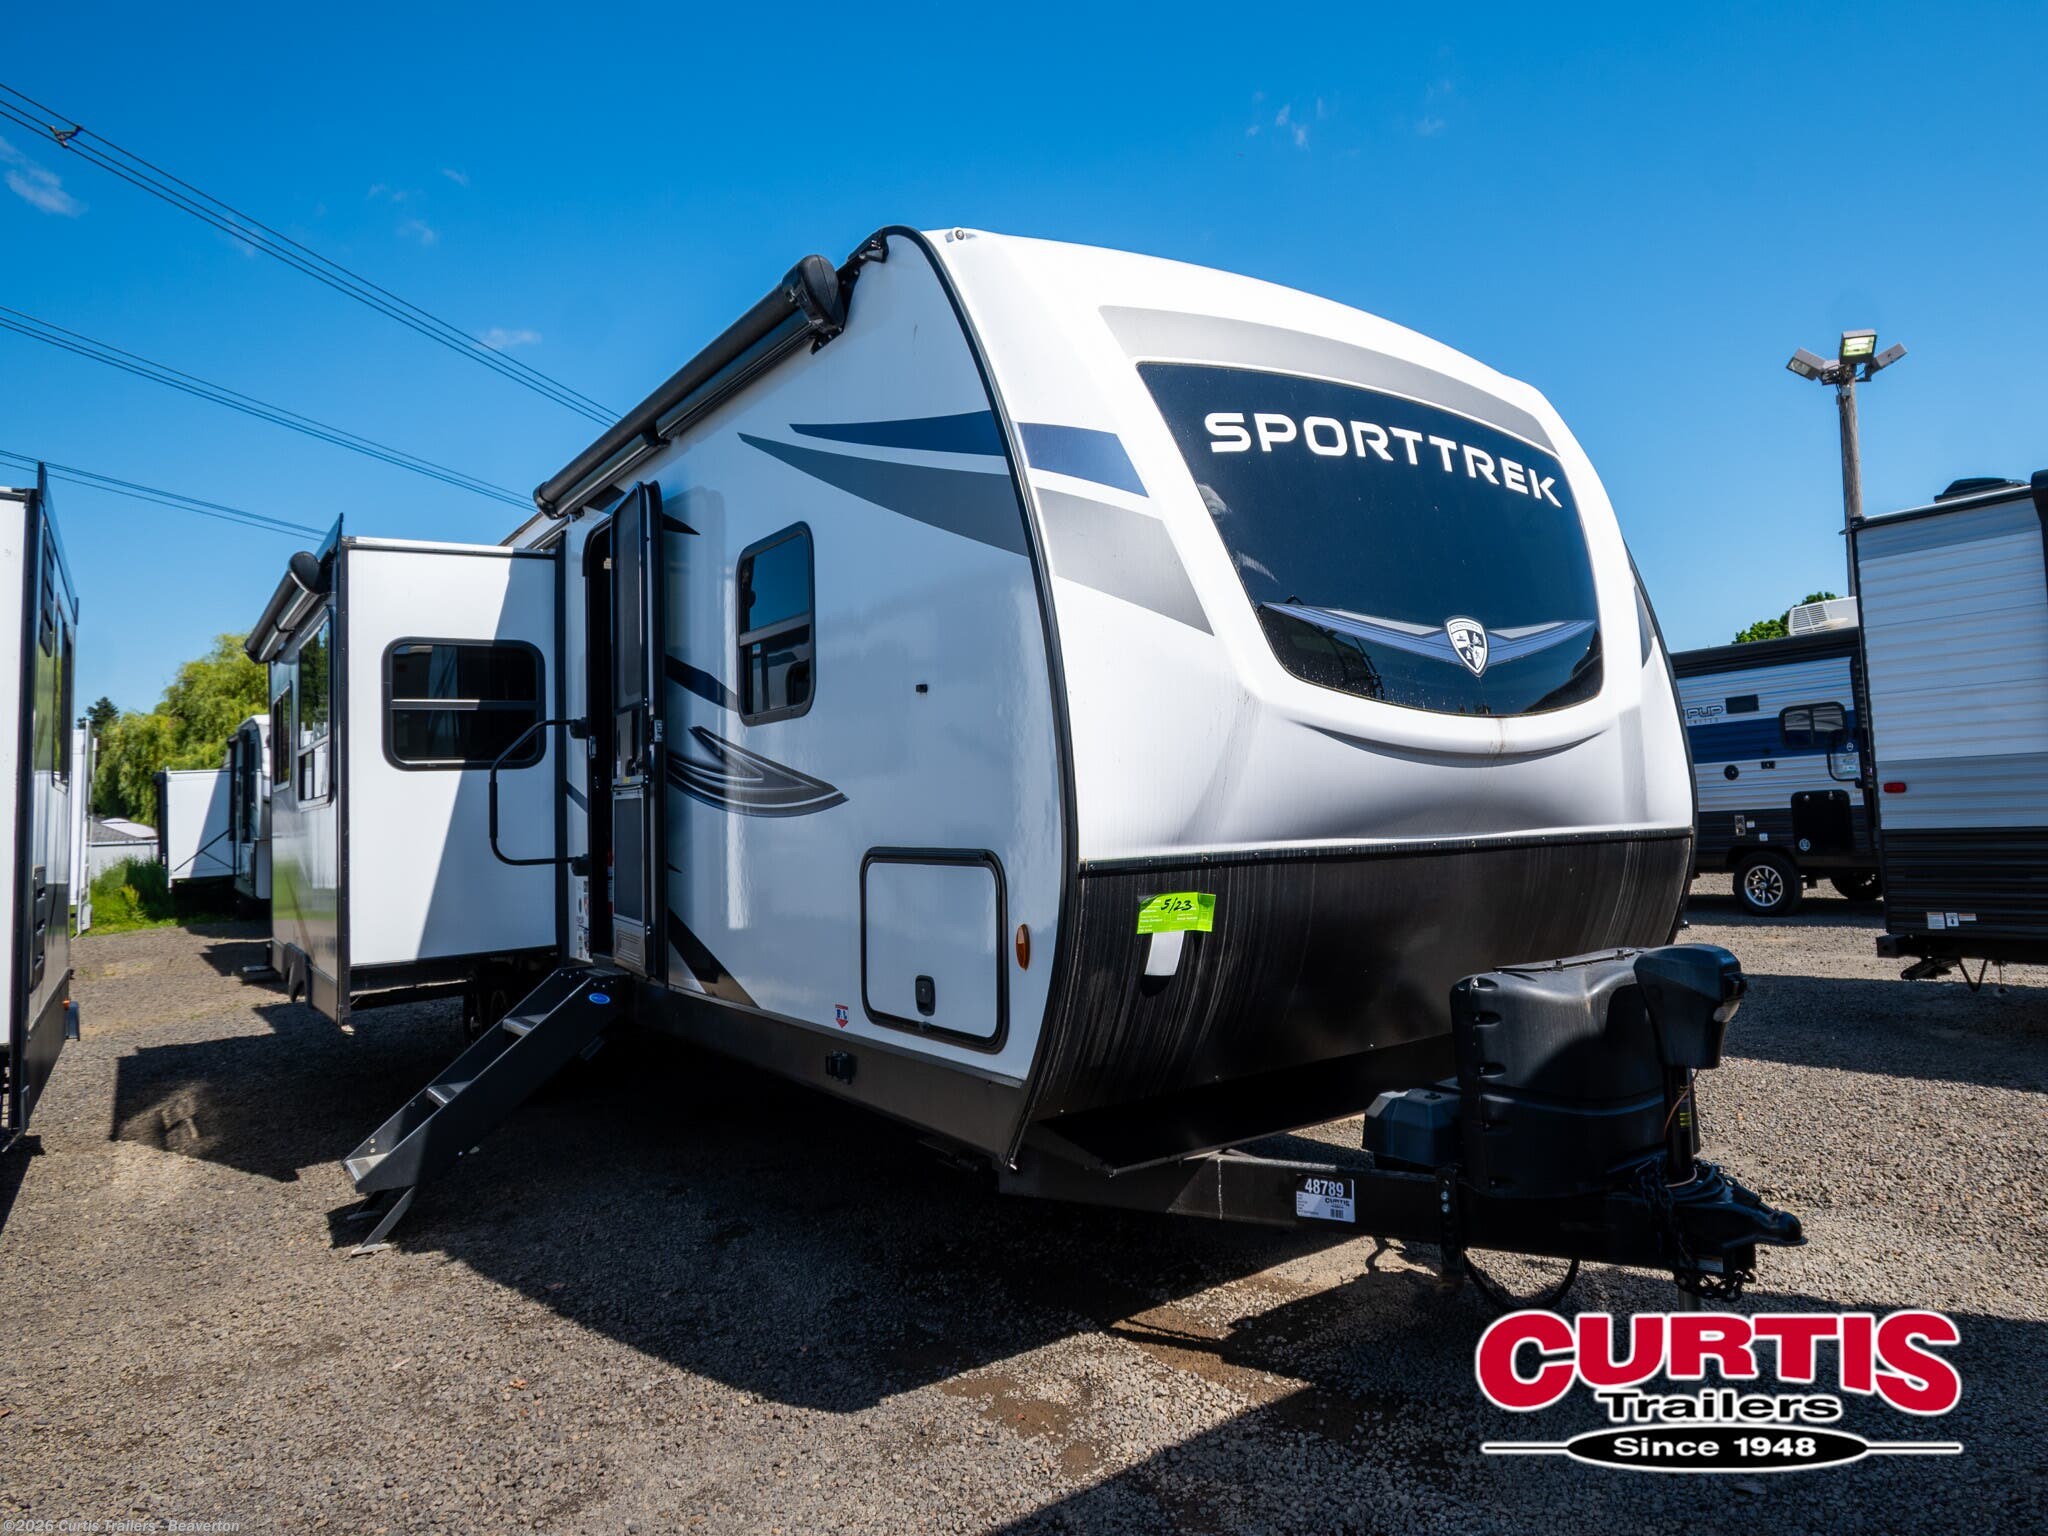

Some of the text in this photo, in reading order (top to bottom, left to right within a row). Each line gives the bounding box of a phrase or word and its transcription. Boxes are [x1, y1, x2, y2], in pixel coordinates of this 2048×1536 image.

[1204, 412, 1563, 508] SPORTTREK
[1686, 704, 1724, 720] PUP
[1160, 898, 1192, 913] 5/23
[1304, 1178, 1344, 1197] 48789
